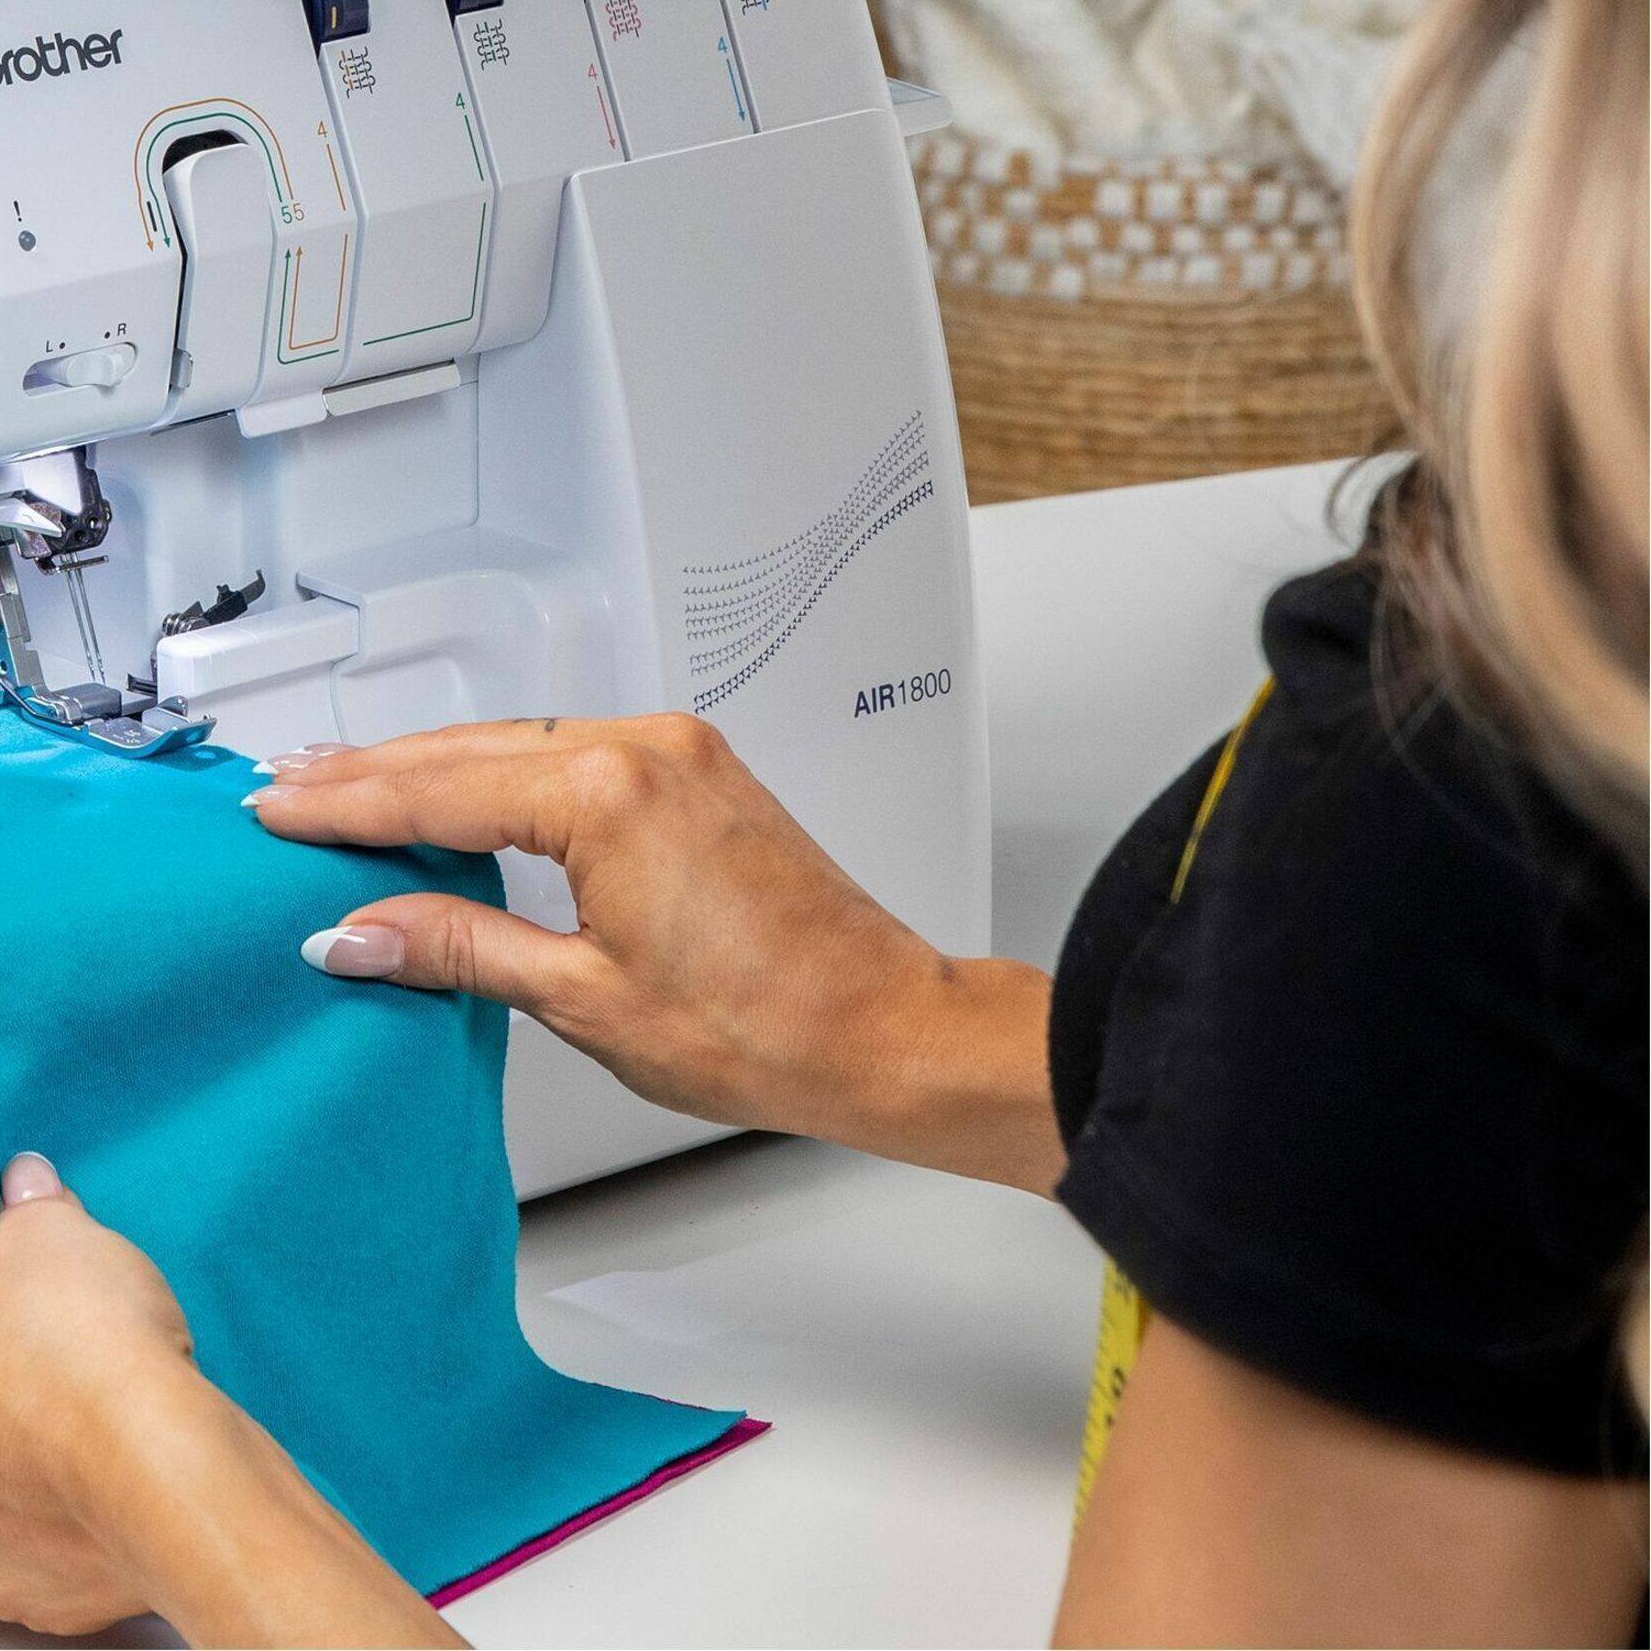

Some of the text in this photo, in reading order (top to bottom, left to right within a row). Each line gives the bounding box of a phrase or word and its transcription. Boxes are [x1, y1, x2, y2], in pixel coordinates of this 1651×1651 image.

[717, 36, 728, 54] 4
[587, 63, 599, 81] 4
[455, 92, 466, 110] 4
[317, 120, 328, 138] 4
[45, 323, 128, 353] L R
[854, 668, 952, 718] AIR1800
